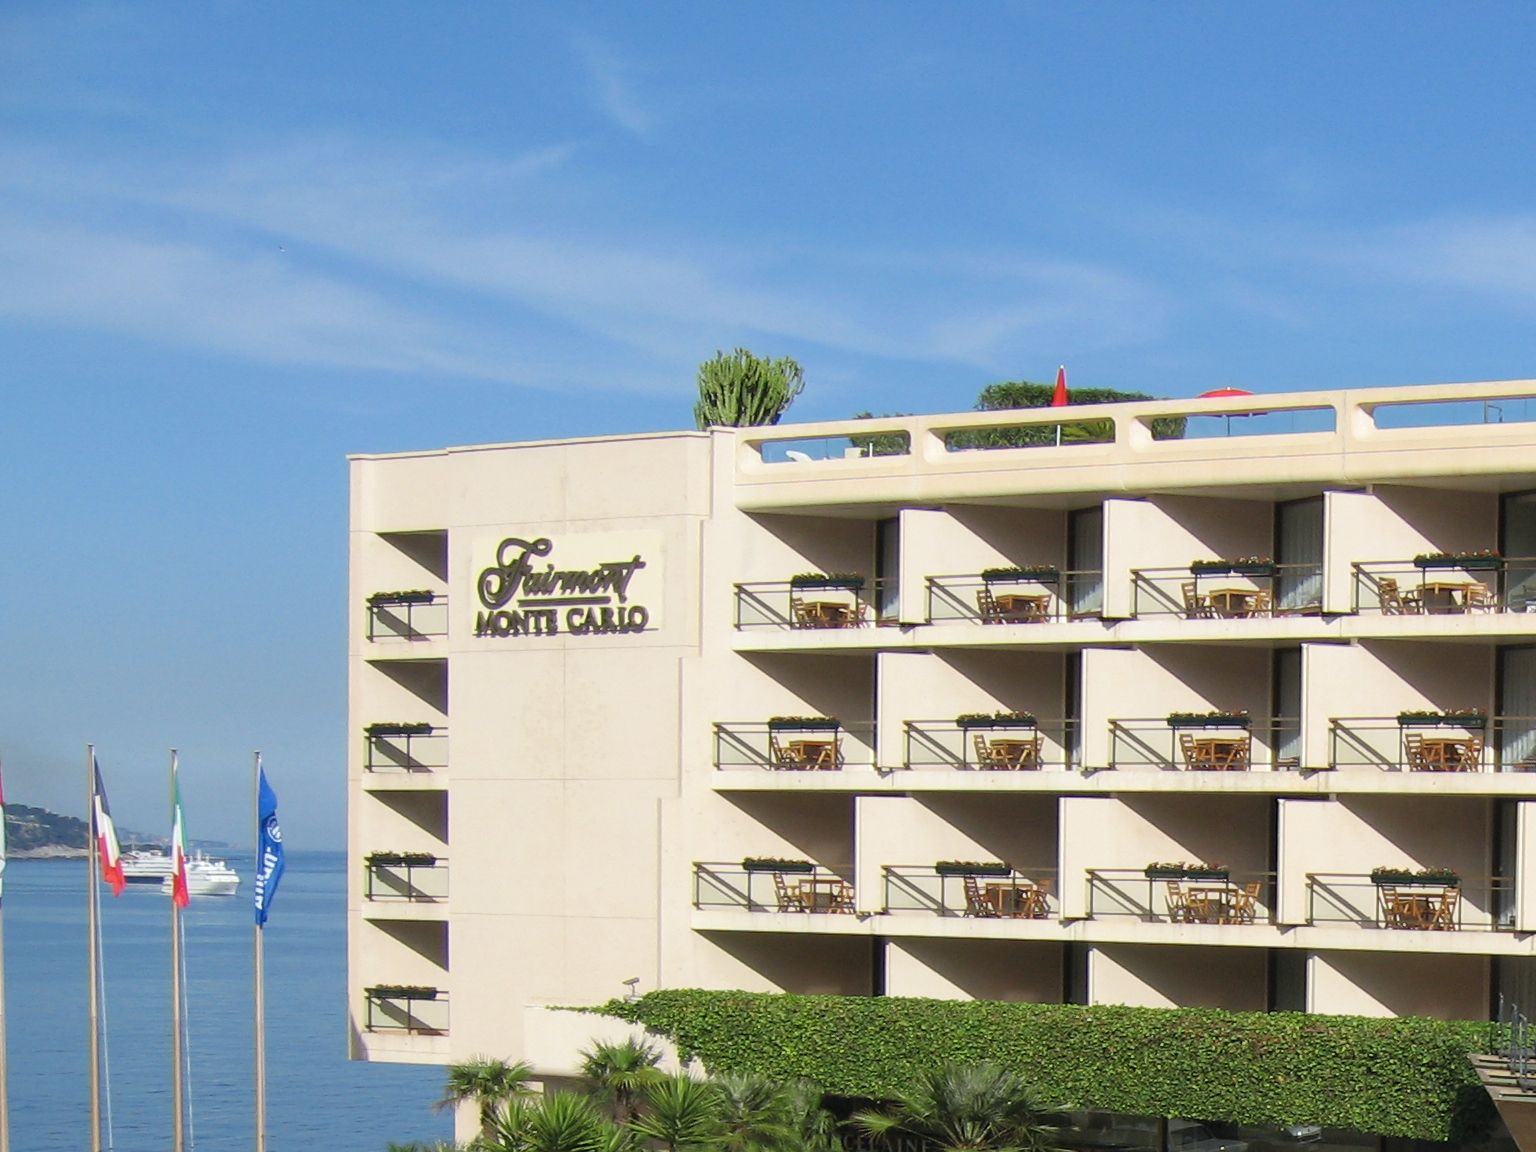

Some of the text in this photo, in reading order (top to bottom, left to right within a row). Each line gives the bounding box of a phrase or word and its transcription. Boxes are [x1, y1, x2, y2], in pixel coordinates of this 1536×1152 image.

[477, 537, 647, 609] Fairmont
[475, 606, 649, 637] MONTE CARLO
